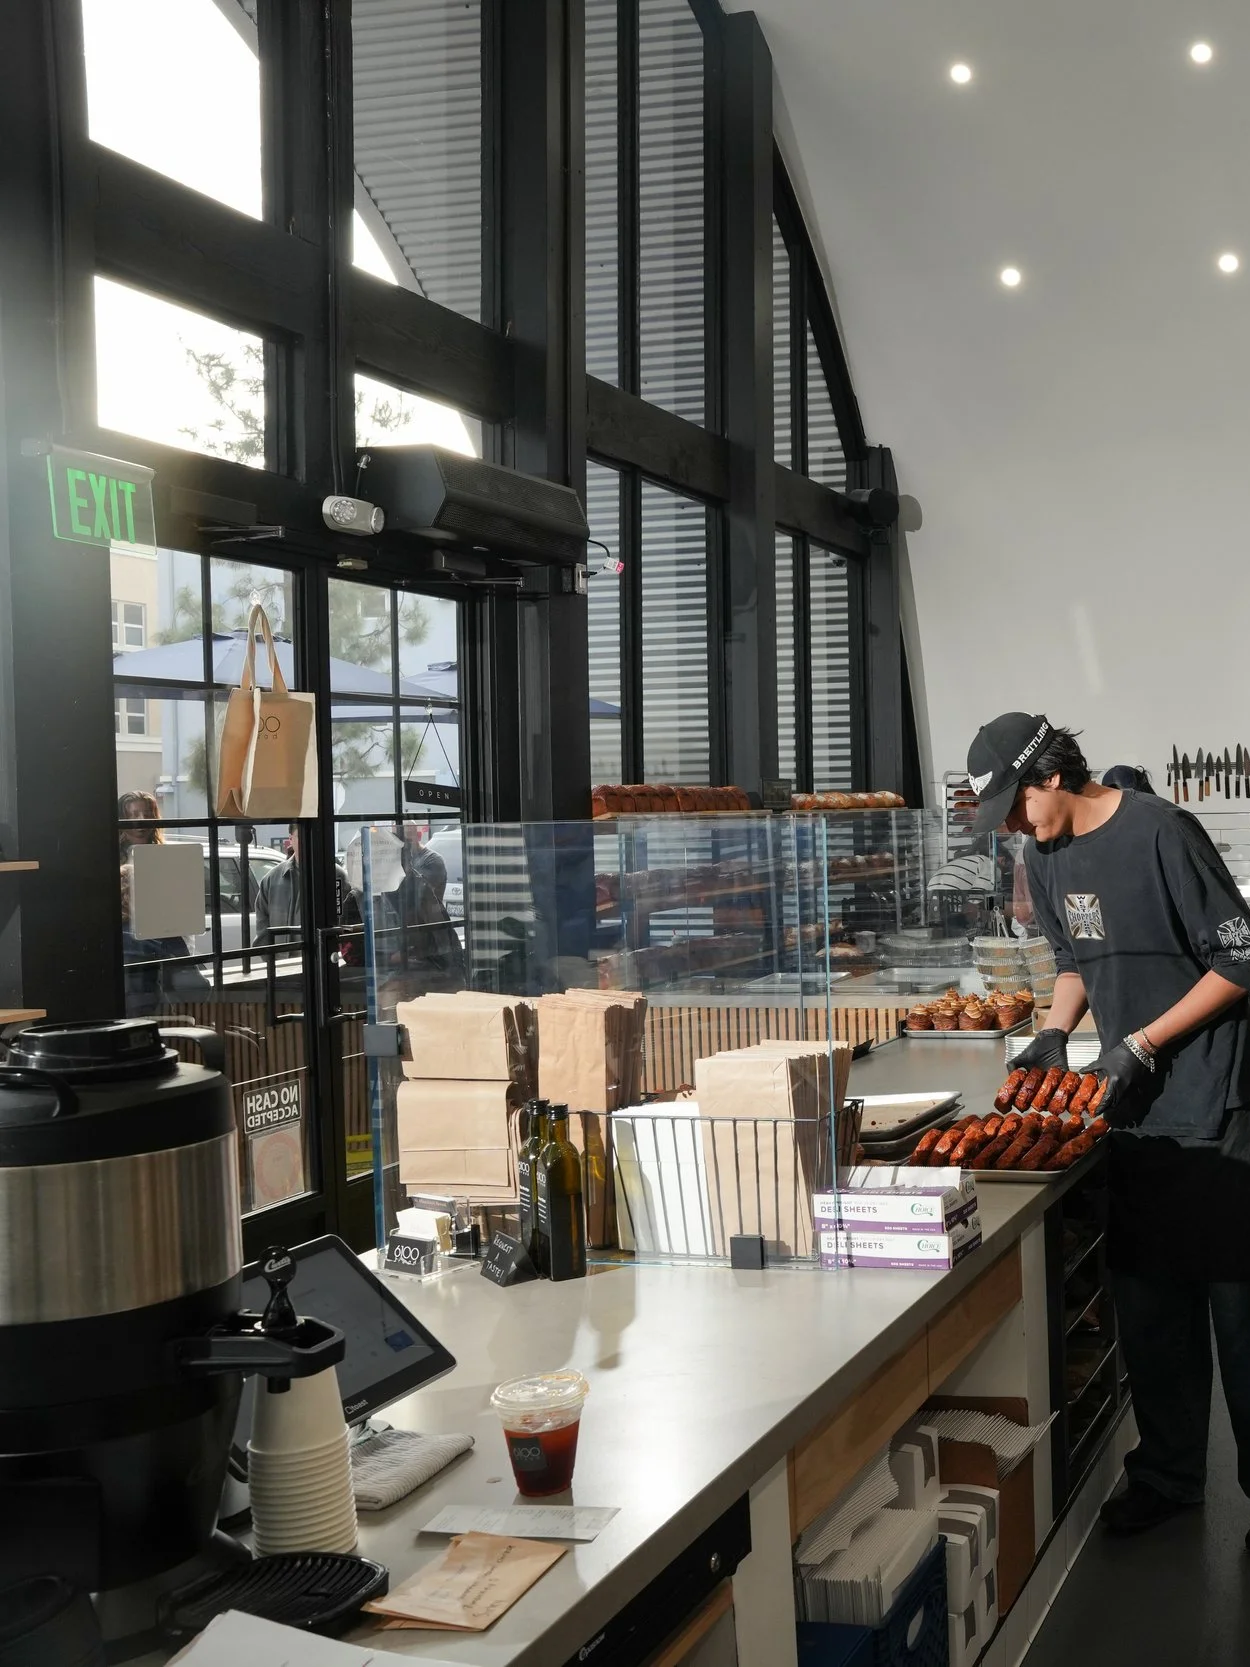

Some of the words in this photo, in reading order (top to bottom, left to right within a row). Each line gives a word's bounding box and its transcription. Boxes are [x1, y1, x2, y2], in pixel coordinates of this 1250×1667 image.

[67, 468, 136, 544] EXIT
[1012, 722, 1049, 770] BREITLING
[419, 789, 450, 800] OPEN
[394, 1245, 420, 1261] 6100
[486, 1260, 505, 1283] TASTE!
